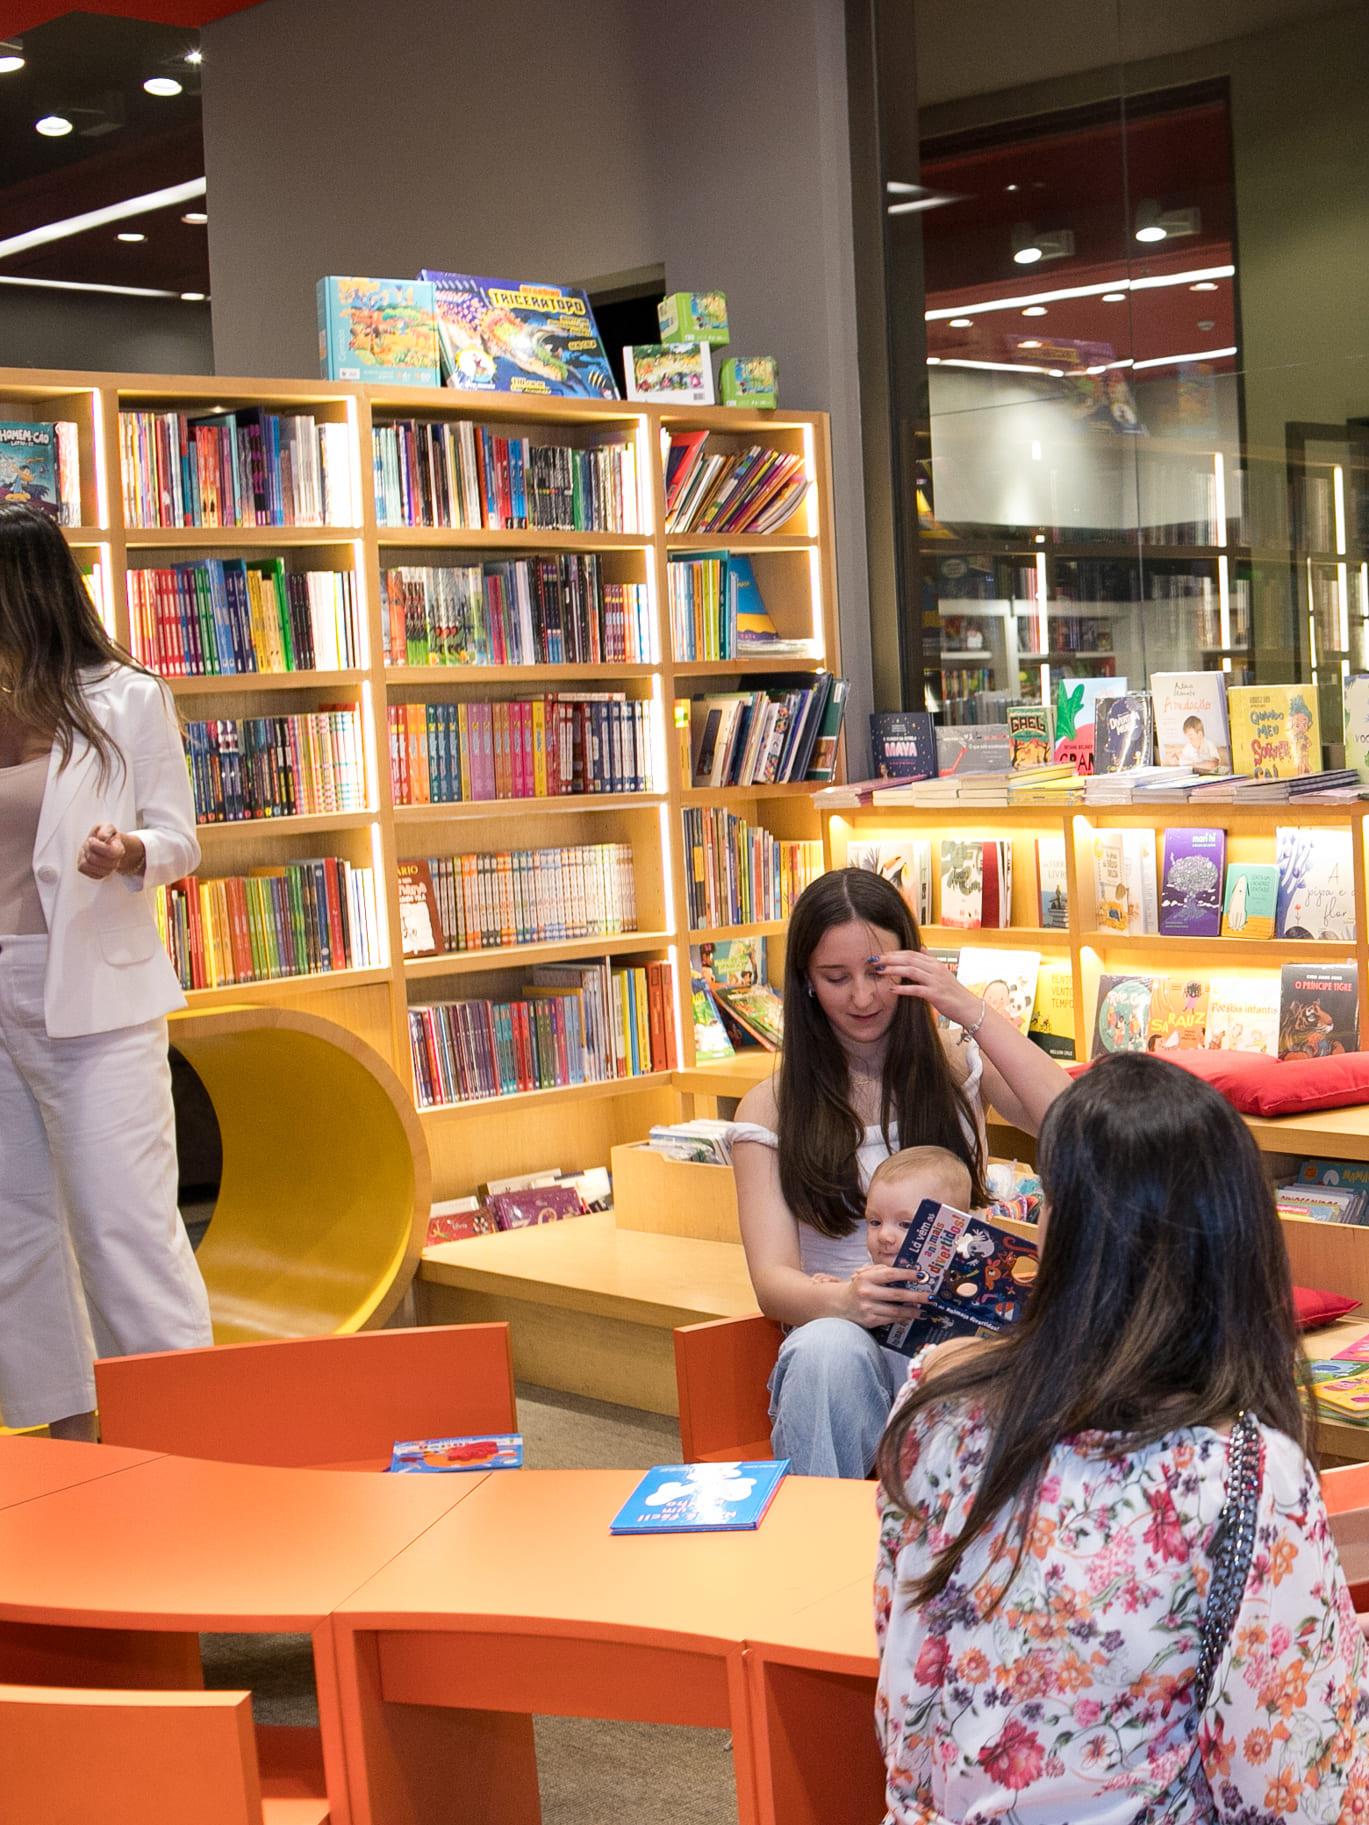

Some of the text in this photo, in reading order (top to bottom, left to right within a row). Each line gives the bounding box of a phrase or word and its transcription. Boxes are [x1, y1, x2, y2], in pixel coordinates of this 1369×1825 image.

[1010, 716, 1046, 734] GAEL
[1250, 710, 1284, 725] QUANDO
[1257, 725, 1279, 739] MEU
[884, 741, 918, 757] MAYA
[1324, 896, 1347, 928] flor
[1295, 979, 1353, 992] O PRÍNCIPE TIGRE
[1211, 1001, 1278, 1015] Poesias infantis
[908, 1213, 936, 1254] Lá vêm os
[924, 1222, 945, 1258] animais
[927, 1214, 966, 1275] divertidos!
